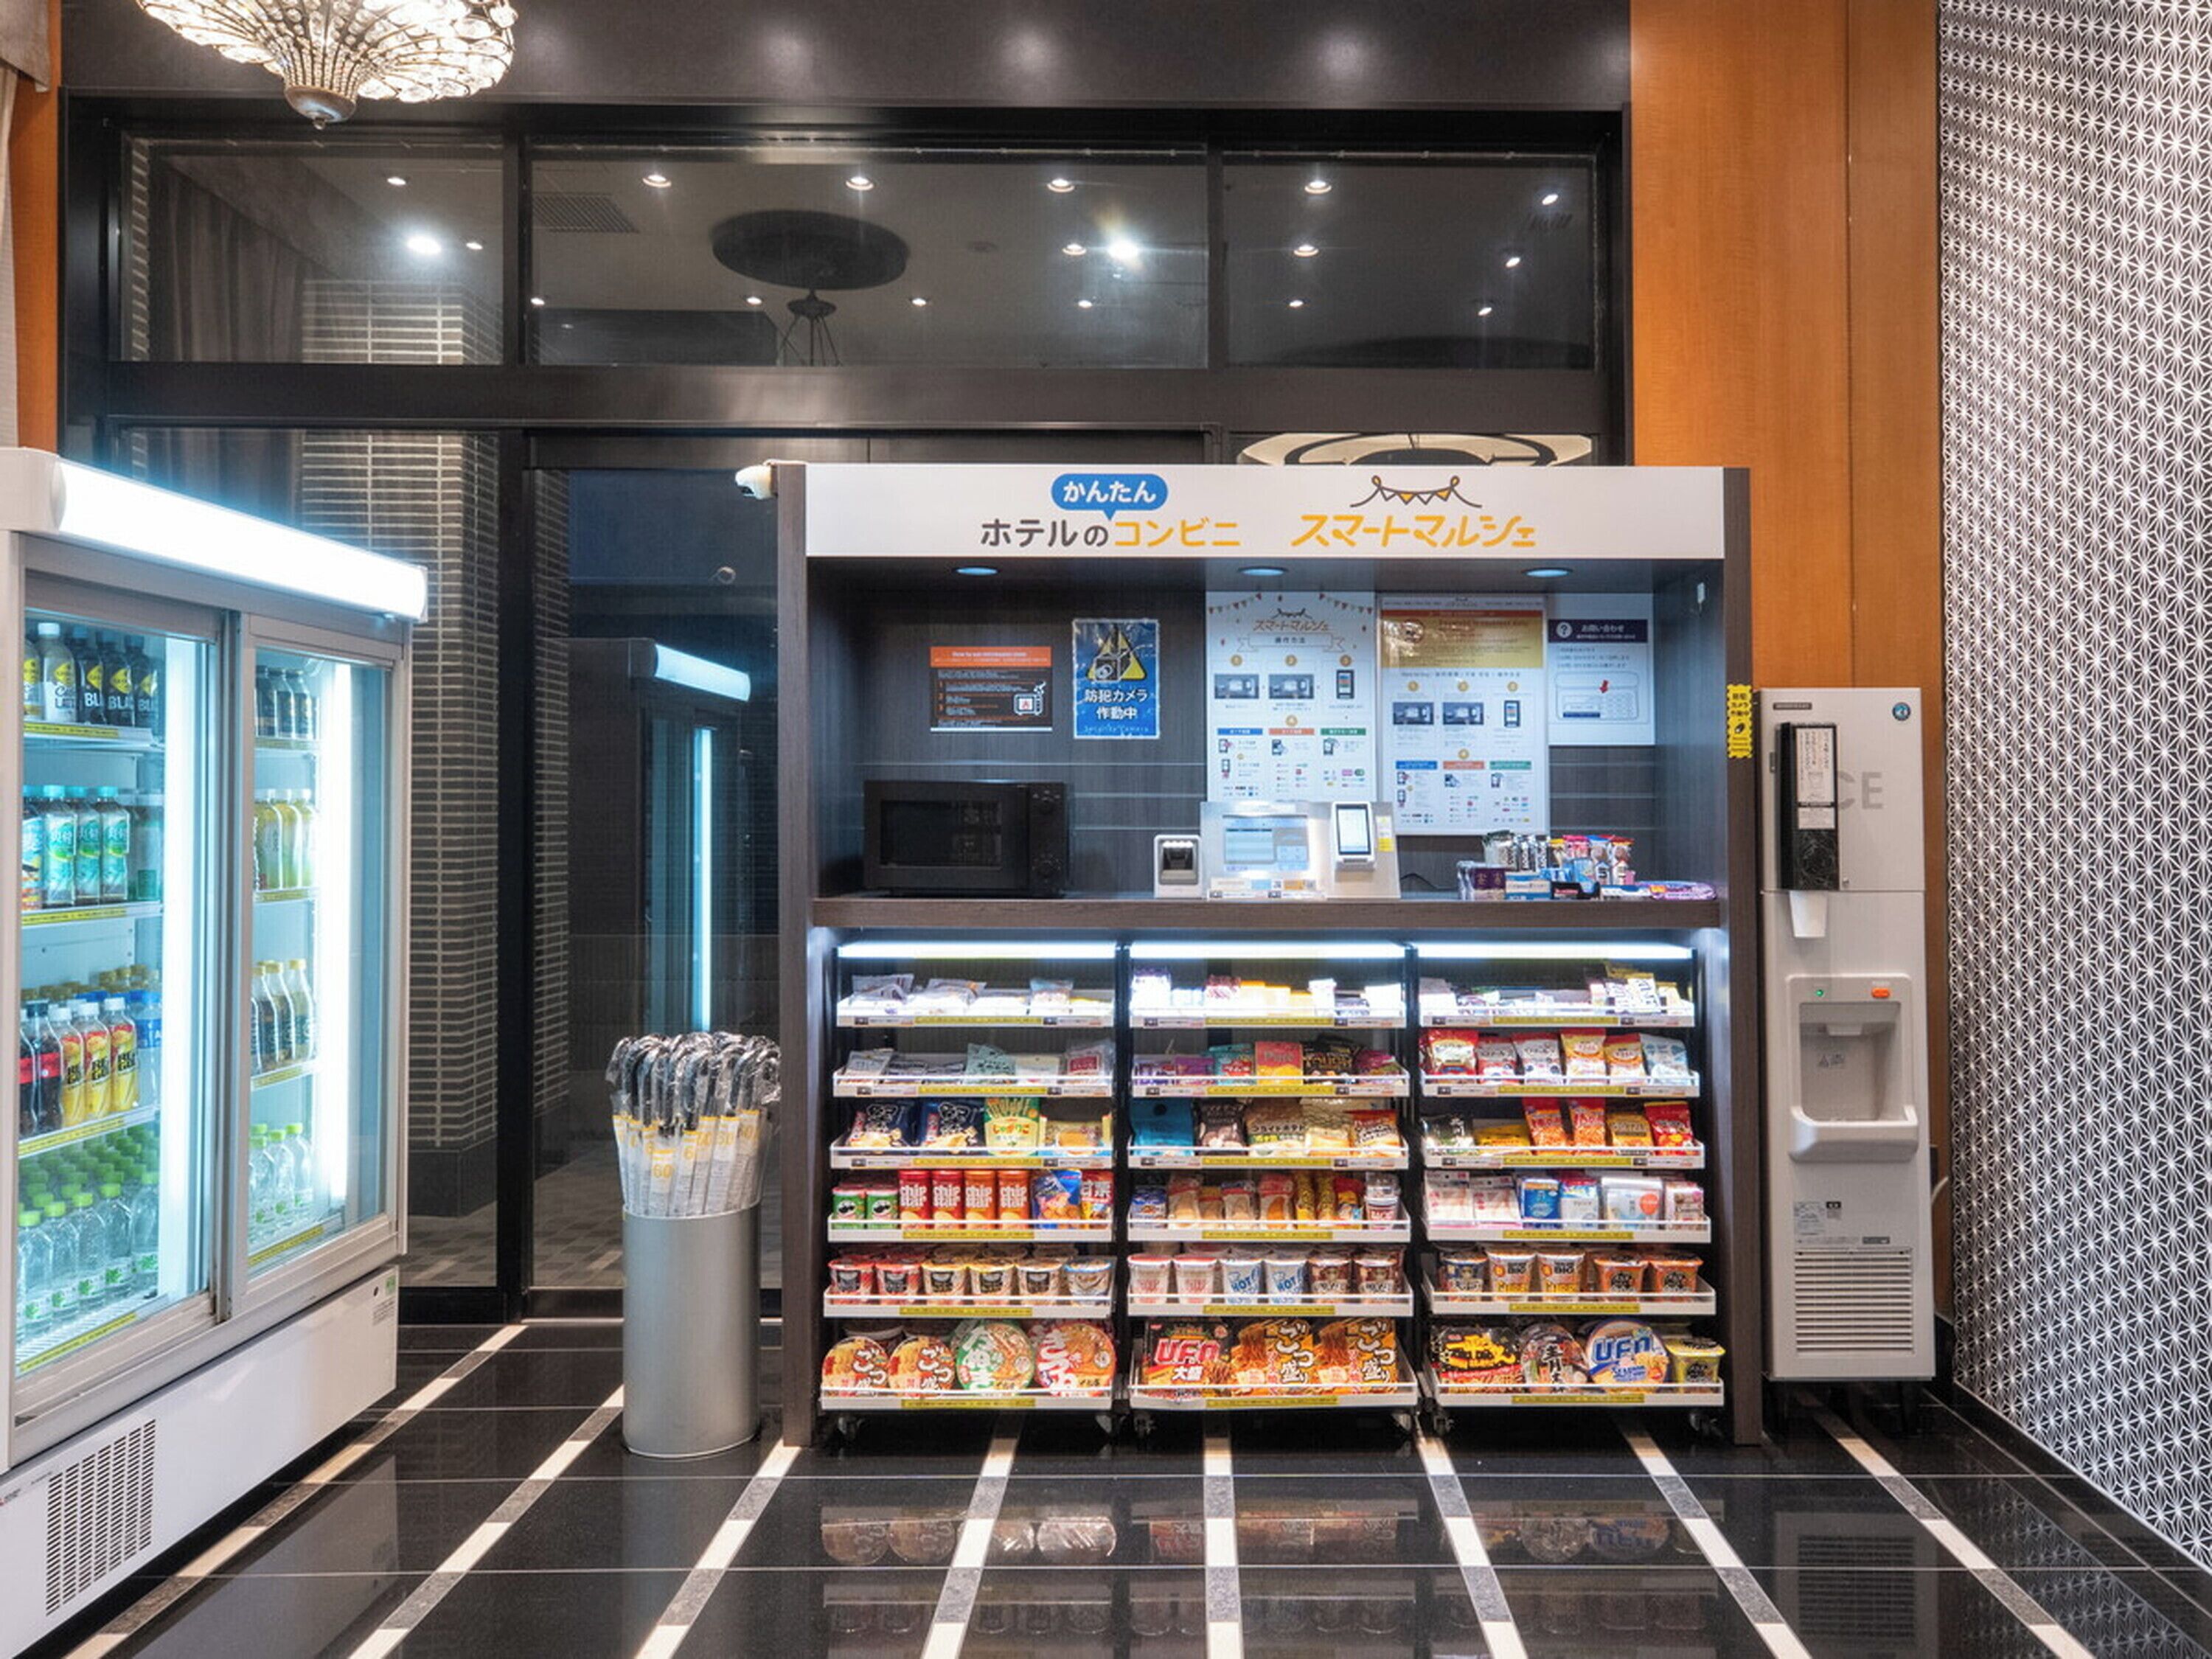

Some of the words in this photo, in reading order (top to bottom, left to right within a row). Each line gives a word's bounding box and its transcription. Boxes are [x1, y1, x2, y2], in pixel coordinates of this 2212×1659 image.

[1062, 481, 1155, 503] かんたん
[981, 517, 1241, 547] ホテルのコンビニ
[1291, 515, 1535, 547] スマートマルシェ
[1085, 689, 1148, 703] 防犯カメラ
[1096, 706, 1138, 720] 作動中
[1838, 771, 1883, 810] CE
[993, 1124, 1029, 1134] じゃがりこ
[653, 1164, 674, 1178] 60
